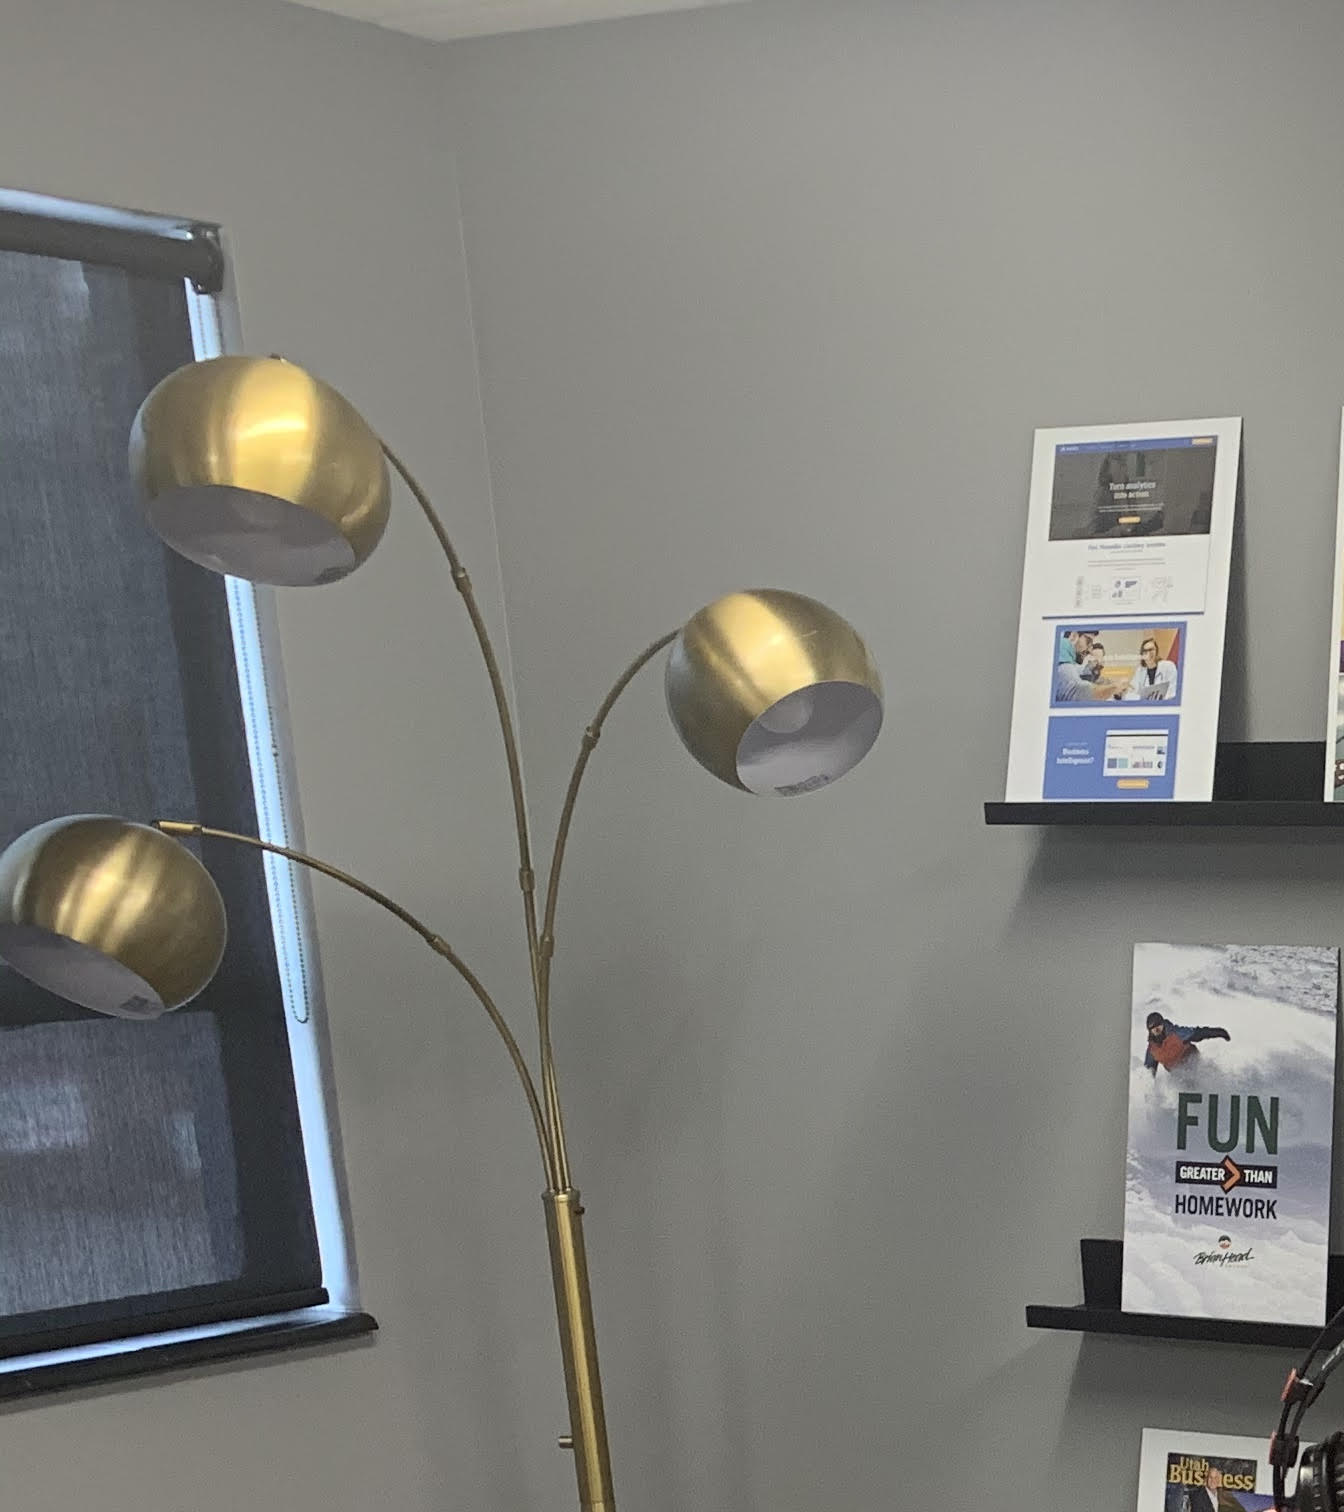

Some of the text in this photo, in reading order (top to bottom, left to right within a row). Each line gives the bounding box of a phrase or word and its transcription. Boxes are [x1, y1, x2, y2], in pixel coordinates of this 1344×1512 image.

[1177, 1092, 1279, 1155] FUN
[1180, 1165, 1272, 1184] GREATER THAN
[1175, 1195, 1277, 1219] HOMEWORK
[1180, 1456, 1209, 1471] Utah
[1169, 1464, 1254, 1490] Busess
